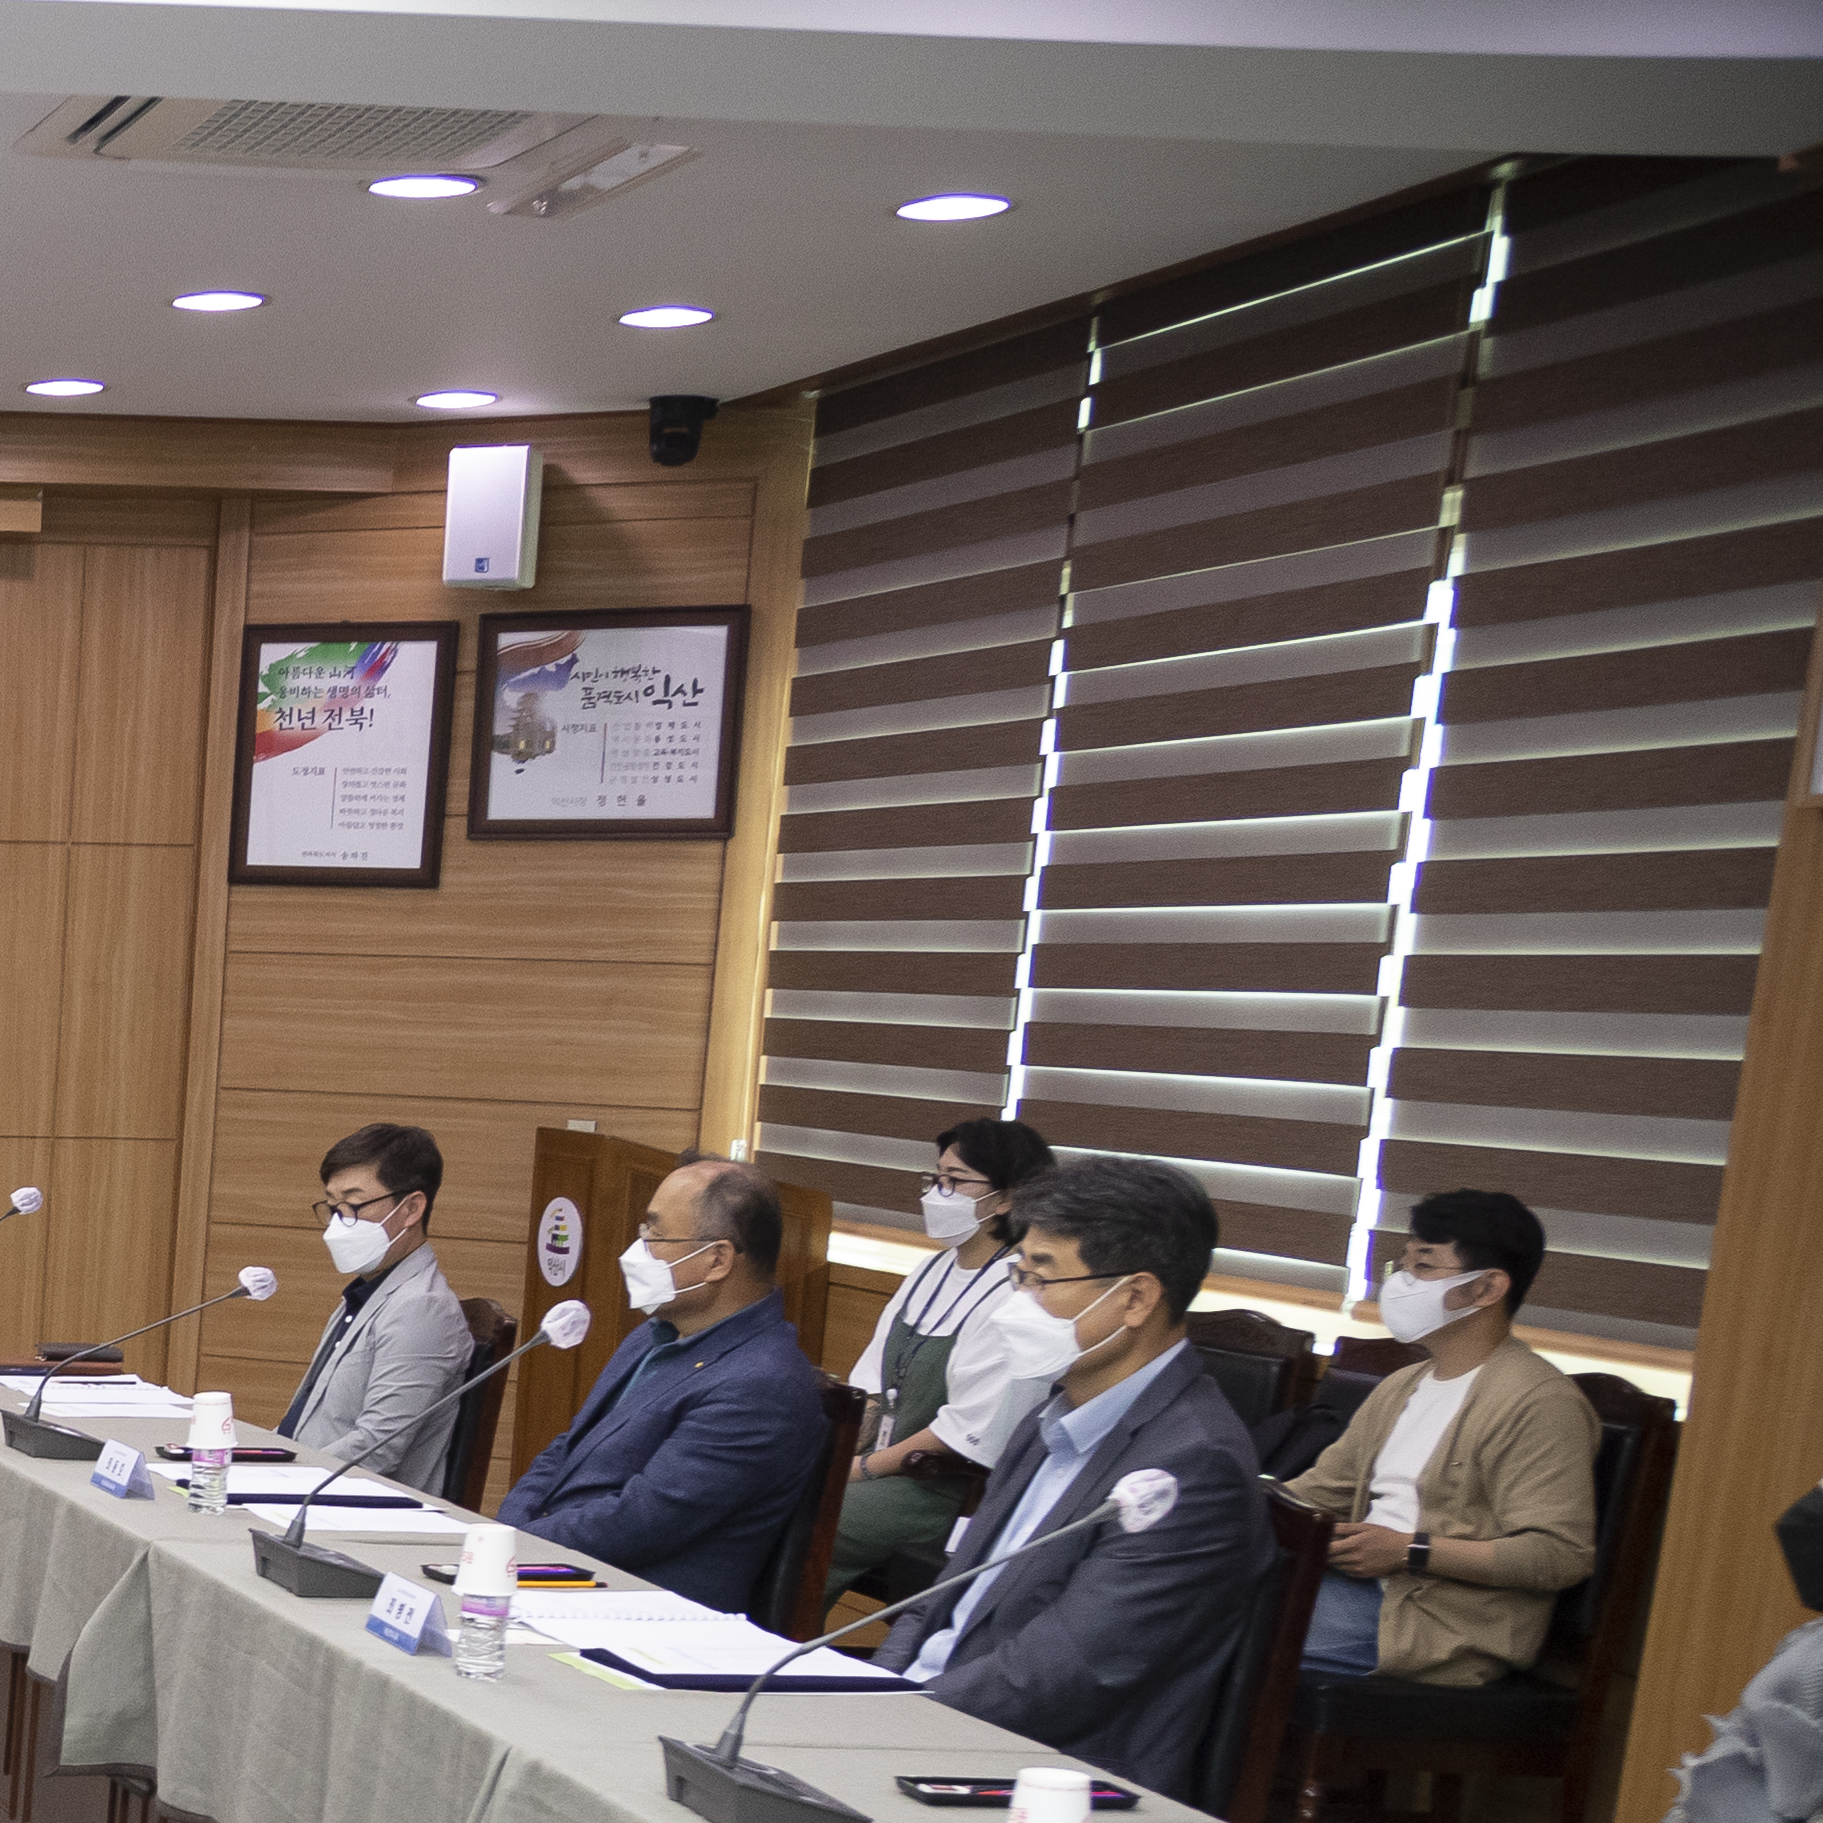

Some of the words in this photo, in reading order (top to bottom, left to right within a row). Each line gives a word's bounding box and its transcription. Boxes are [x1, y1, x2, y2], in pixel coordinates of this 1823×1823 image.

[278, 666, 326, 680] 아름다운
[643, 674, 704, 710] 익산
[273, 706, 317, 732] 천년
[322, 706, 374, 732] 전북!
